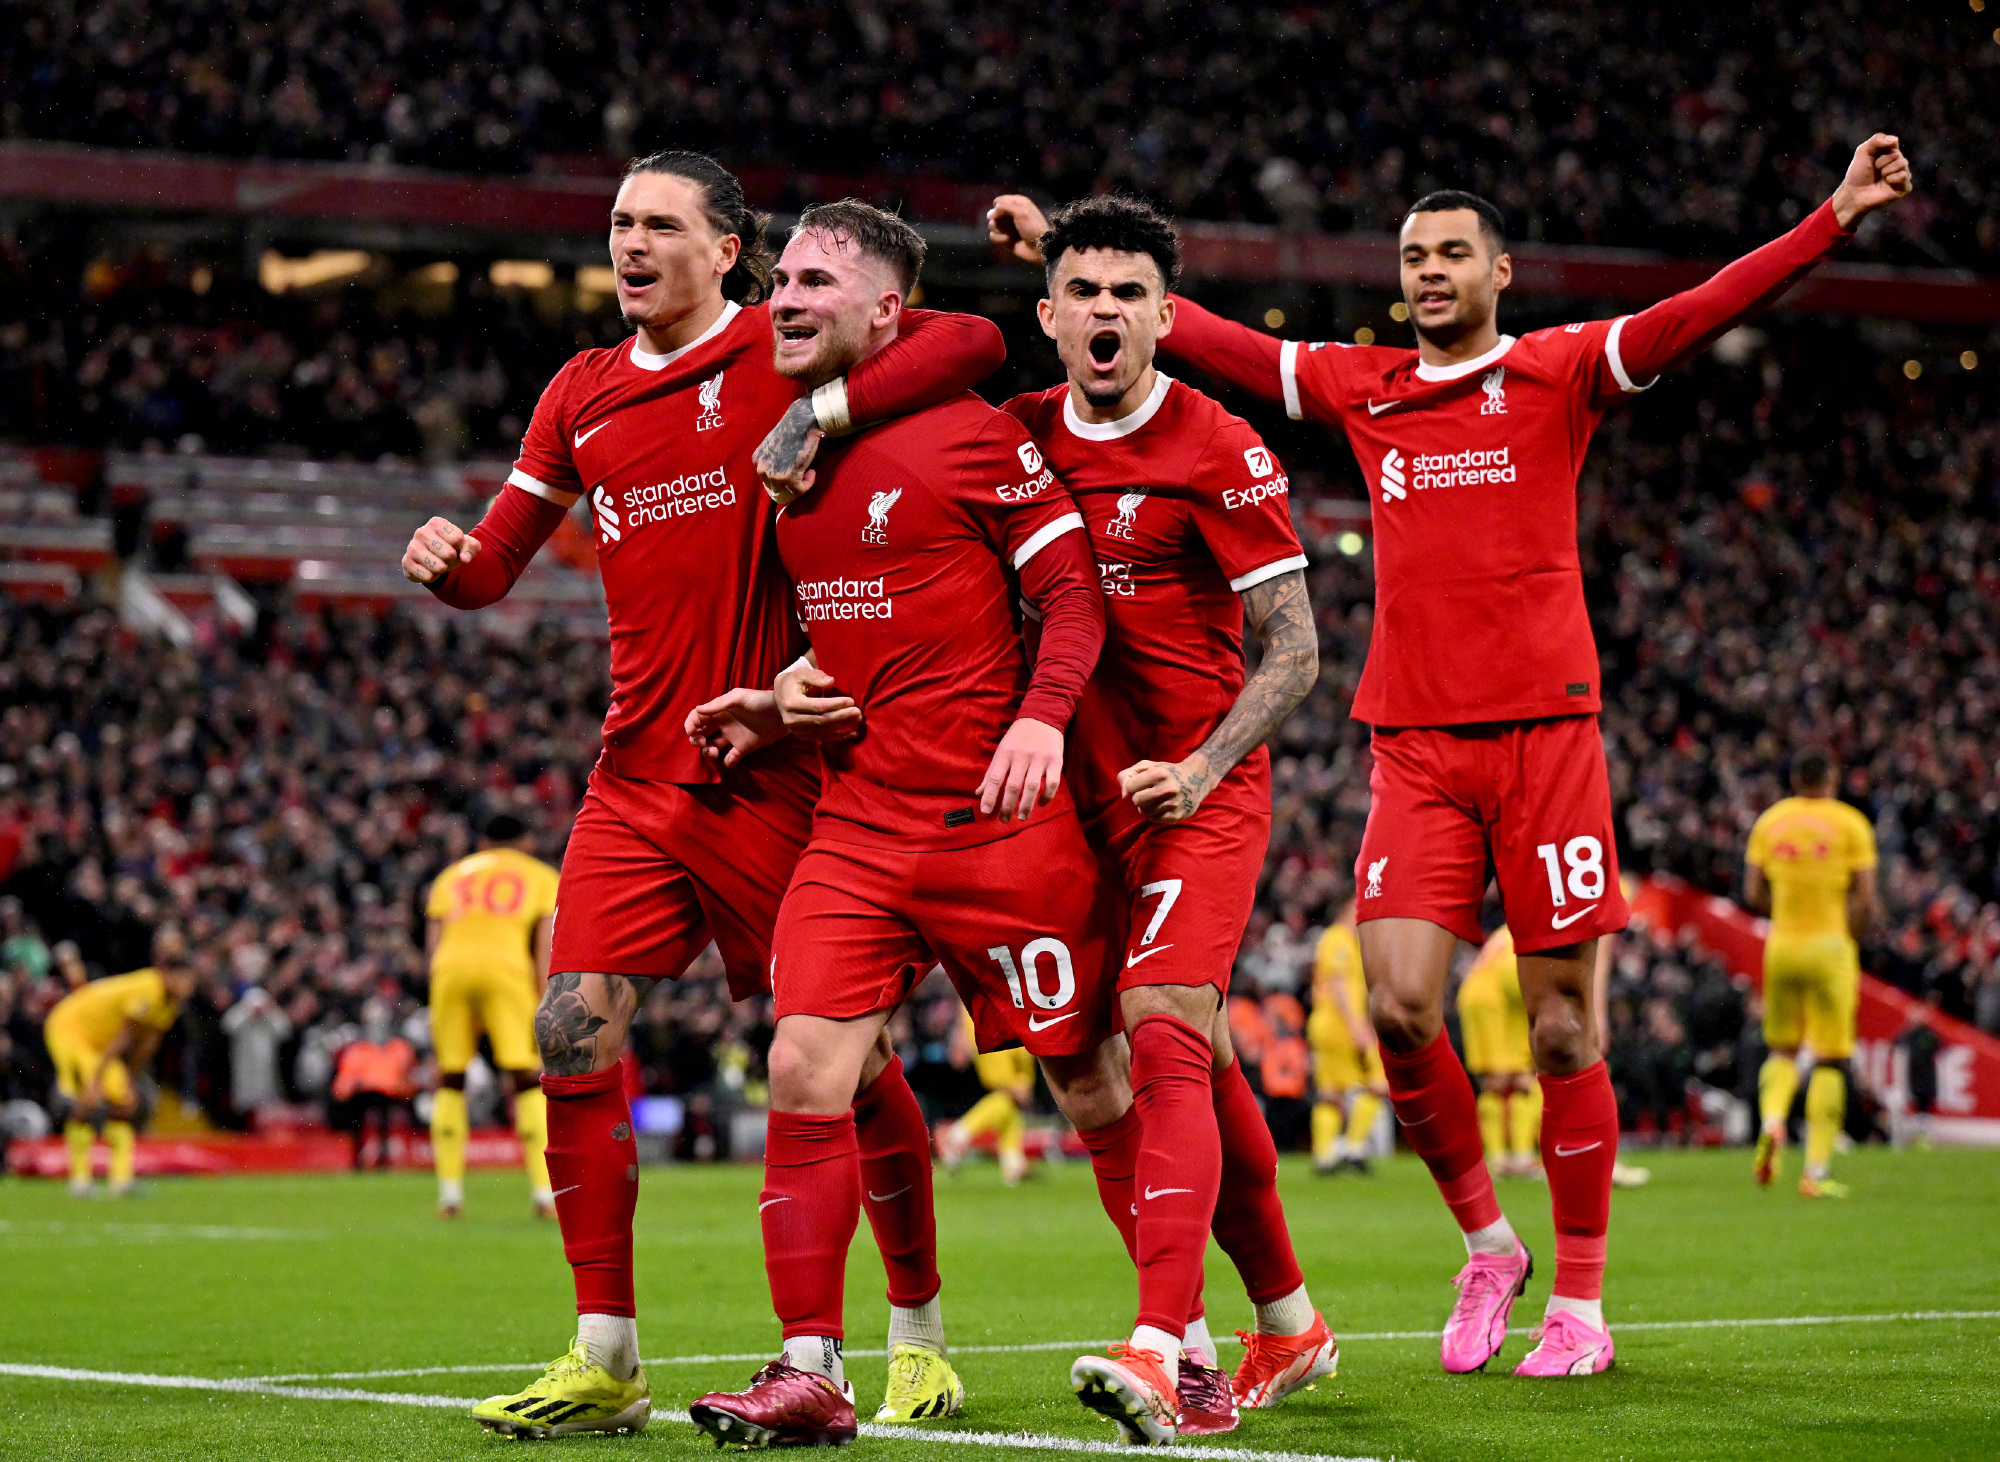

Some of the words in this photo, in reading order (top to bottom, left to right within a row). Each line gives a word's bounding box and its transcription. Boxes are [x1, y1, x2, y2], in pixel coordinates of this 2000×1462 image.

[1412, 446, 1509, 472] standard
[624, 466, 727, 508] standard
[996, 468, 1055, 502] Exped
[1413, 464, 1516, 490] chartered
[628, 484, 736, 527] chartered
[796, 576, 884, 601] standard
[804, 598, 892, 621] chartered
[1537, 835, 1605, 907] 18
[1141, 879, 1183, 946] 7
[987, 936, 1076, 1010] 10
[820, 1380, 836, 1395] COPA
